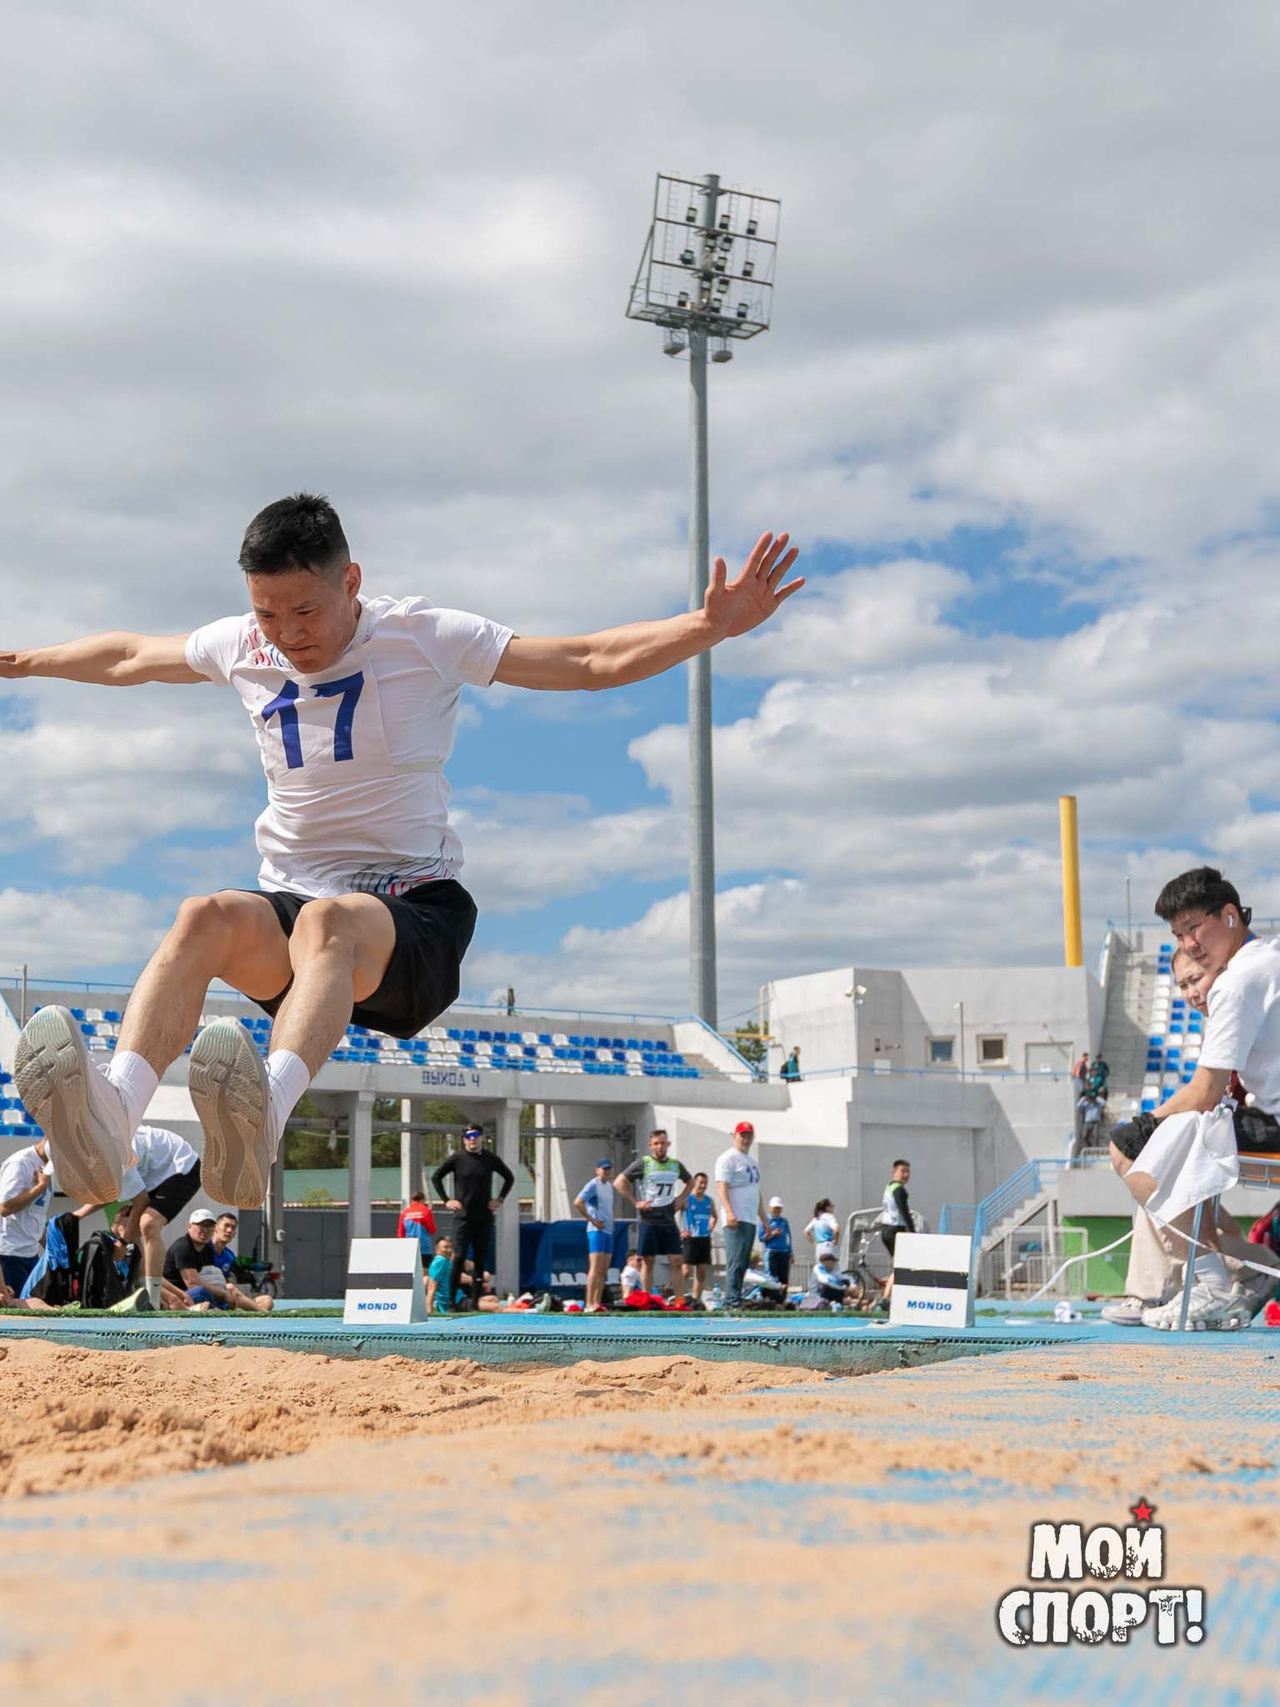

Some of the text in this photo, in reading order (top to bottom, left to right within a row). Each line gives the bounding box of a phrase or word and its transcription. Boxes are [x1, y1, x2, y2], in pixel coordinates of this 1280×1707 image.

[261, 670, 365, 769] 17
[422, 1070, 480, 1087] ВЫХОД 4
[656, 1183, 673, 1196] 77
[357, 1302, 398, 1311] MONDO
[907, 1300, 952, 1311] MONDO
